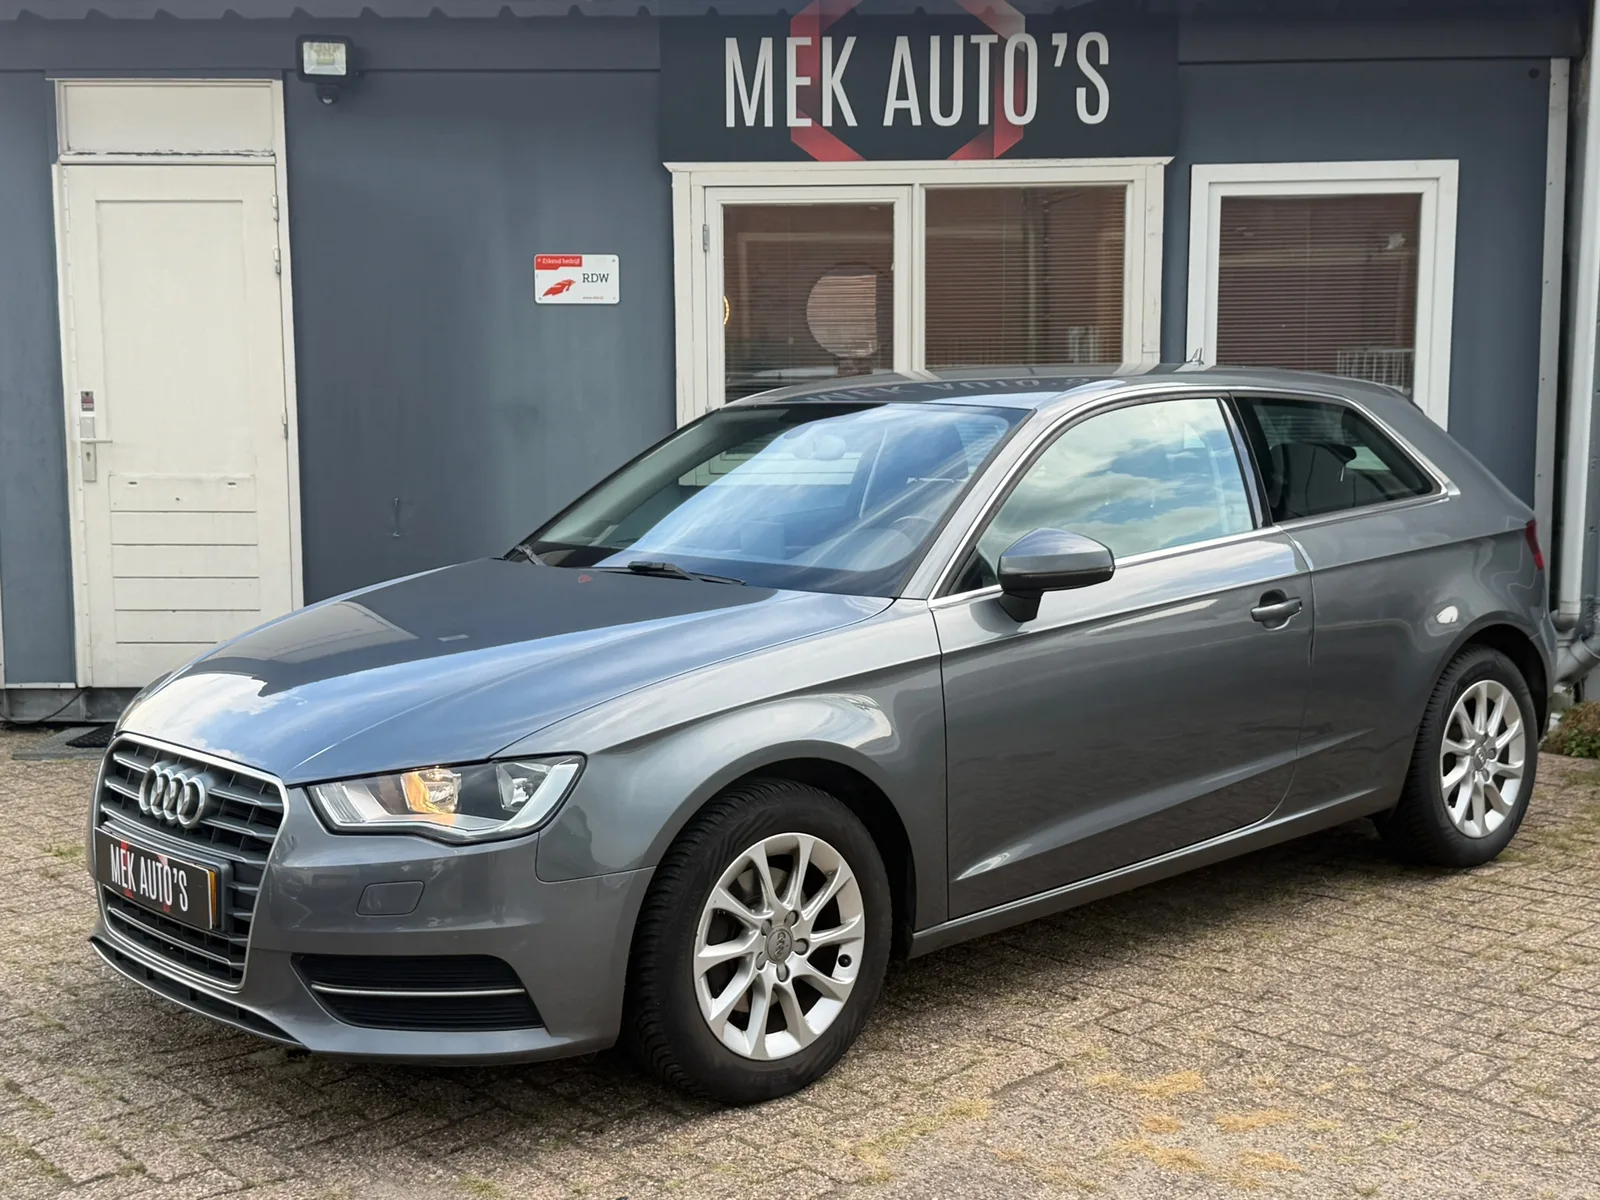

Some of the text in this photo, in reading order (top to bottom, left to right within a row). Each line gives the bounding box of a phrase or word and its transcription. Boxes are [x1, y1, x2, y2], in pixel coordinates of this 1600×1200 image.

[725, 31, 1110, 128] MEK AUTO'S
[582, 273, 609, 283] RDW
[110, 843, 189, 912] MEK AUTO'S
